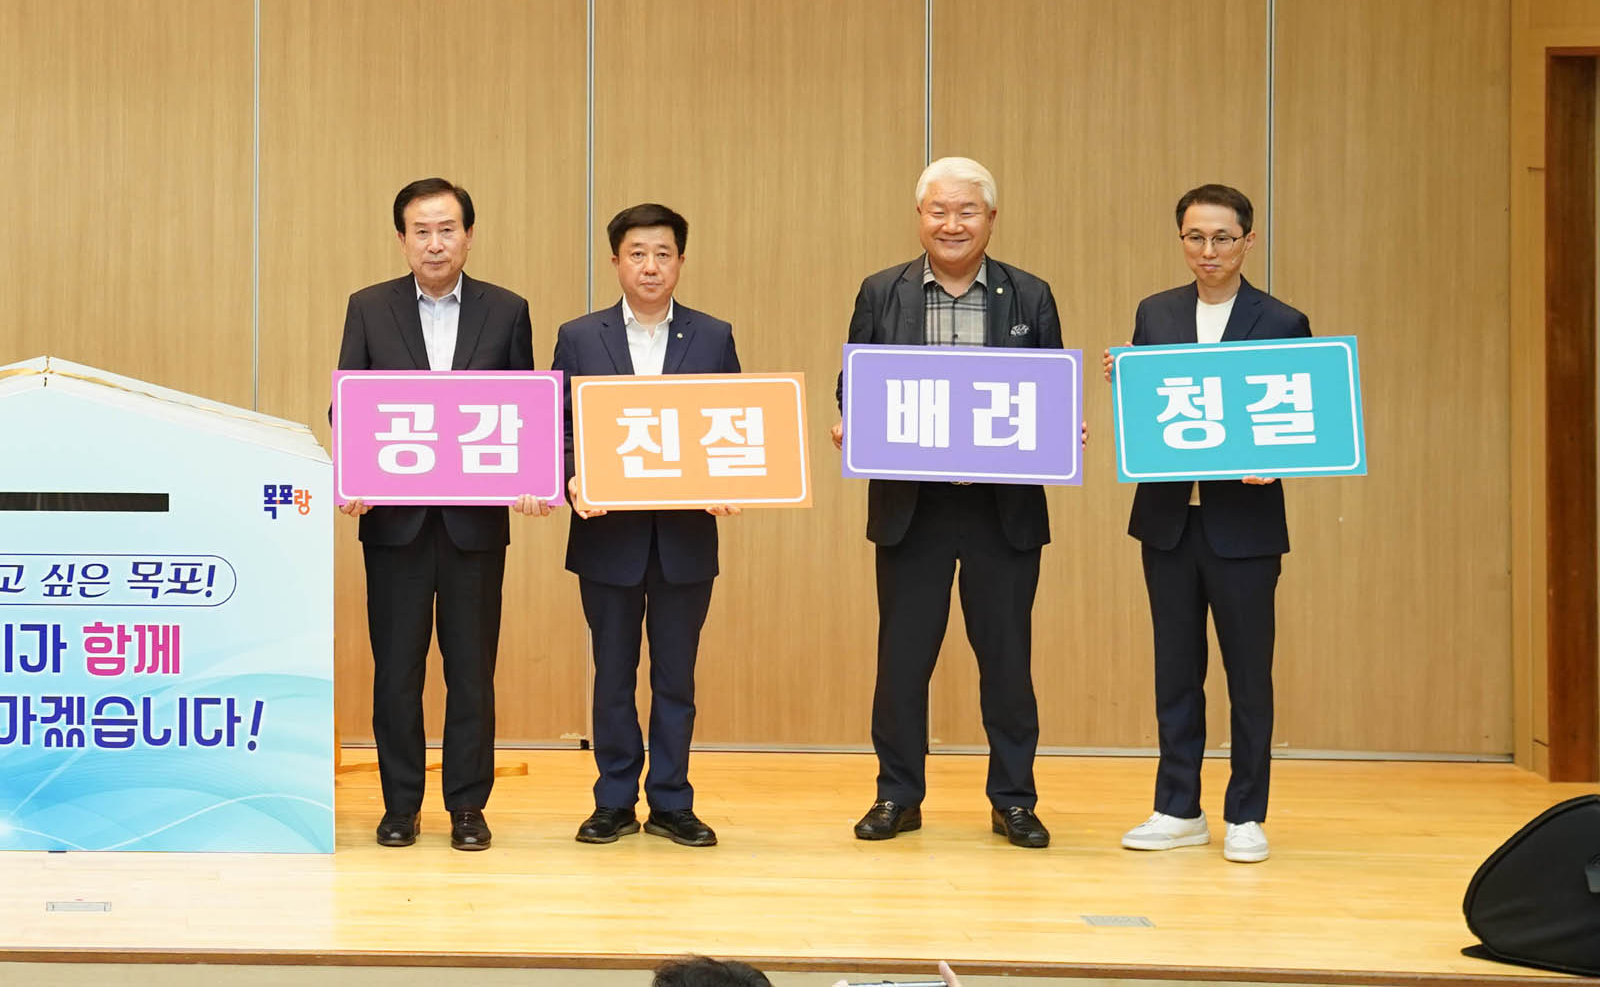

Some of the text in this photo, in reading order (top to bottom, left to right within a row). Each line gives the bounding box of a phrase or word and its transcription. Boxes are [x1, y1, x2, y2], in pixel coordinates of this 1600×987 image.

[40, 563, 111, 599] 싶은
[126, 561, 216, 600] 목포!
[83, 621, 180, 677] 함께
